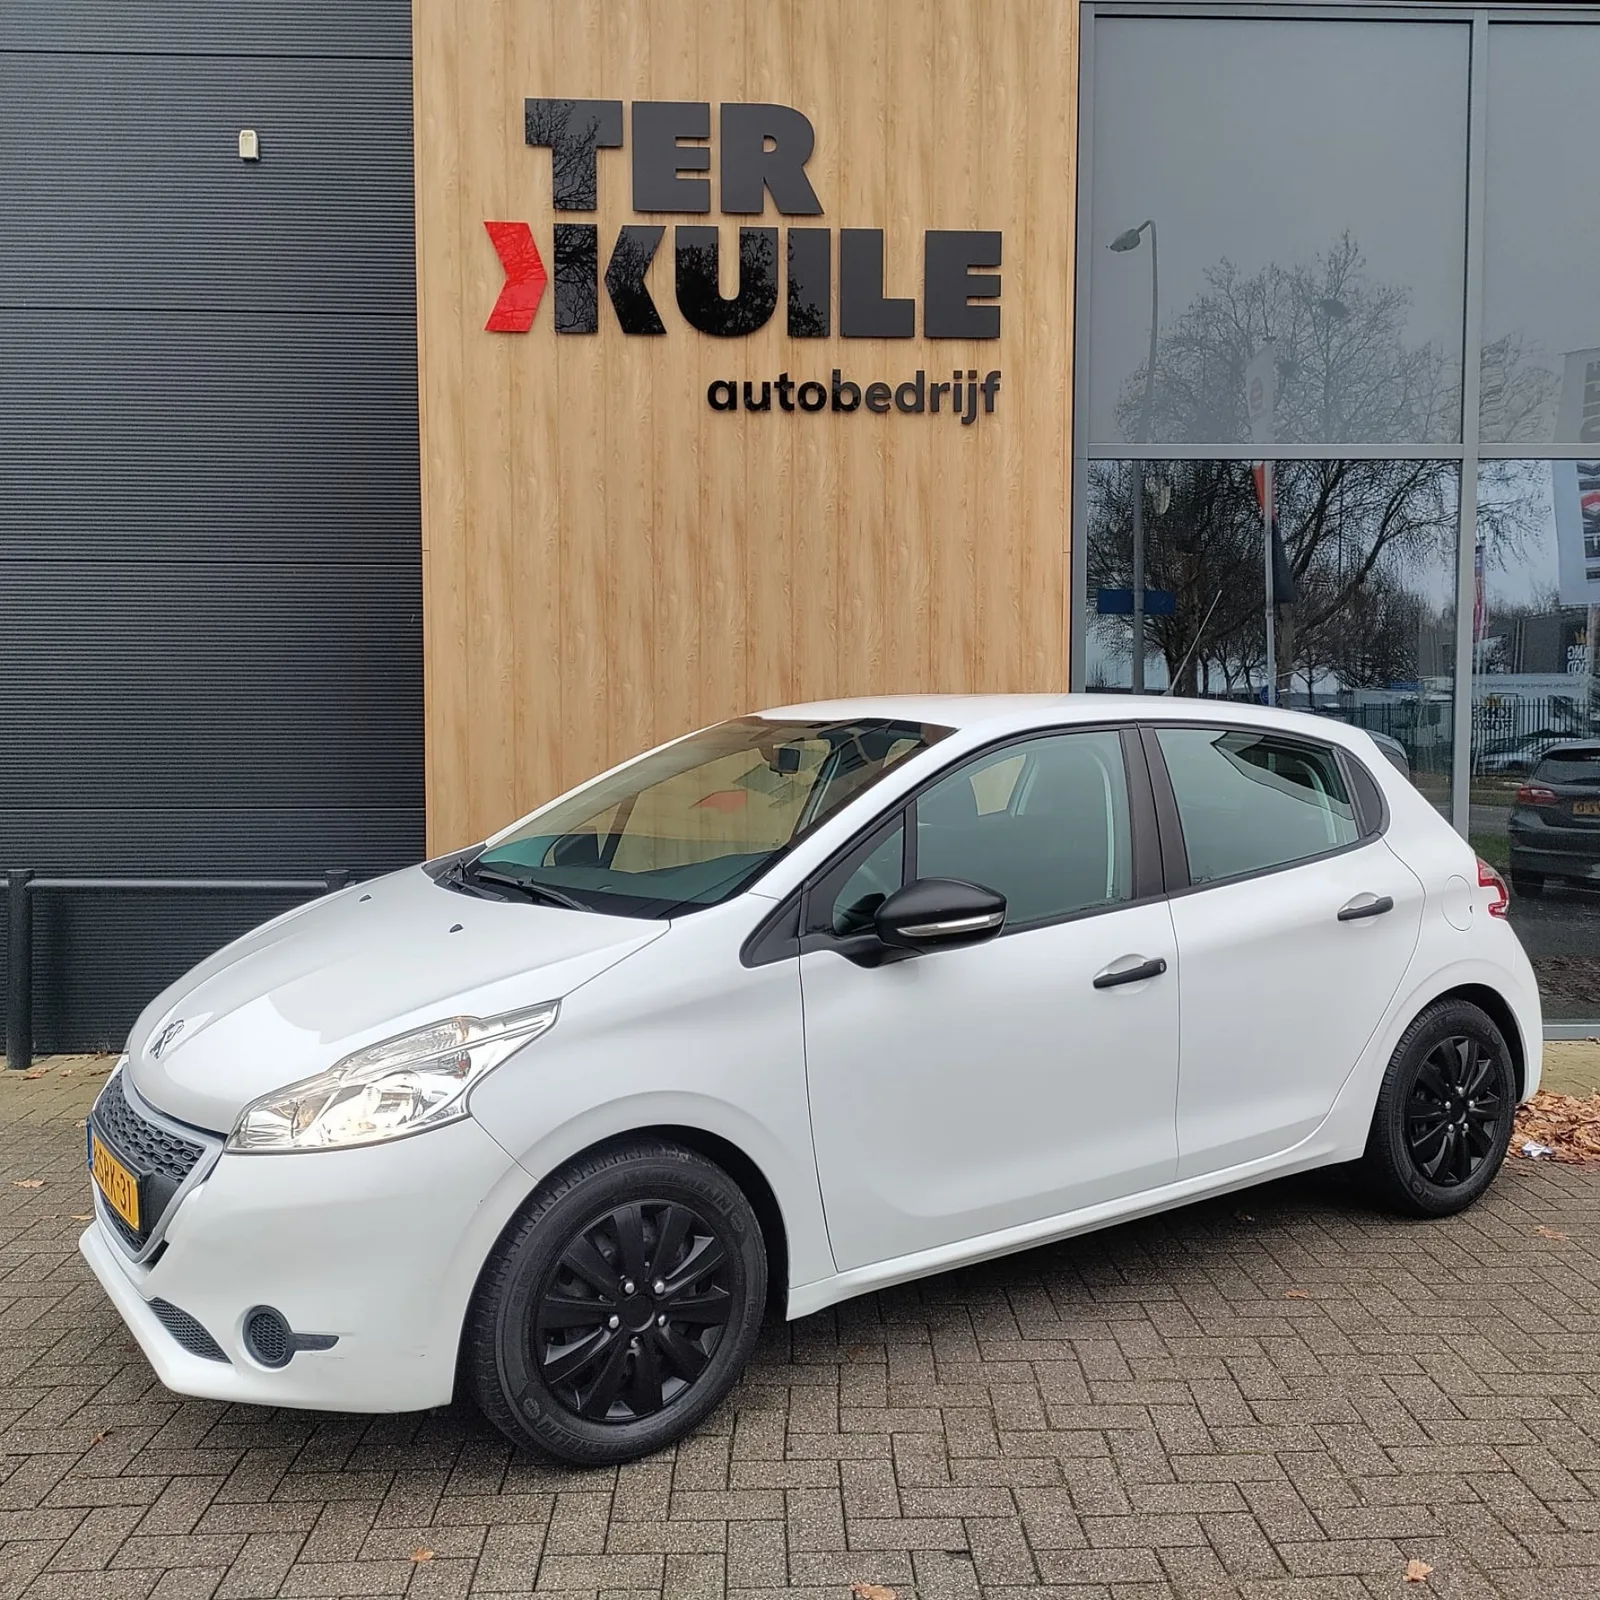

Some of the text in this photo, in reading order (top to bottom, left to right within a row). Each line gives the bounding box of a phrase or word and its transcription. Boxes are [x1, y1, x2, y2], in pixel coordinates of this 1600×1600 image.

[525, 98, 824, 214] TER
[553, 223, 1002, 338] KUILE
[707, 369, 1001, 424] autobedrijf
